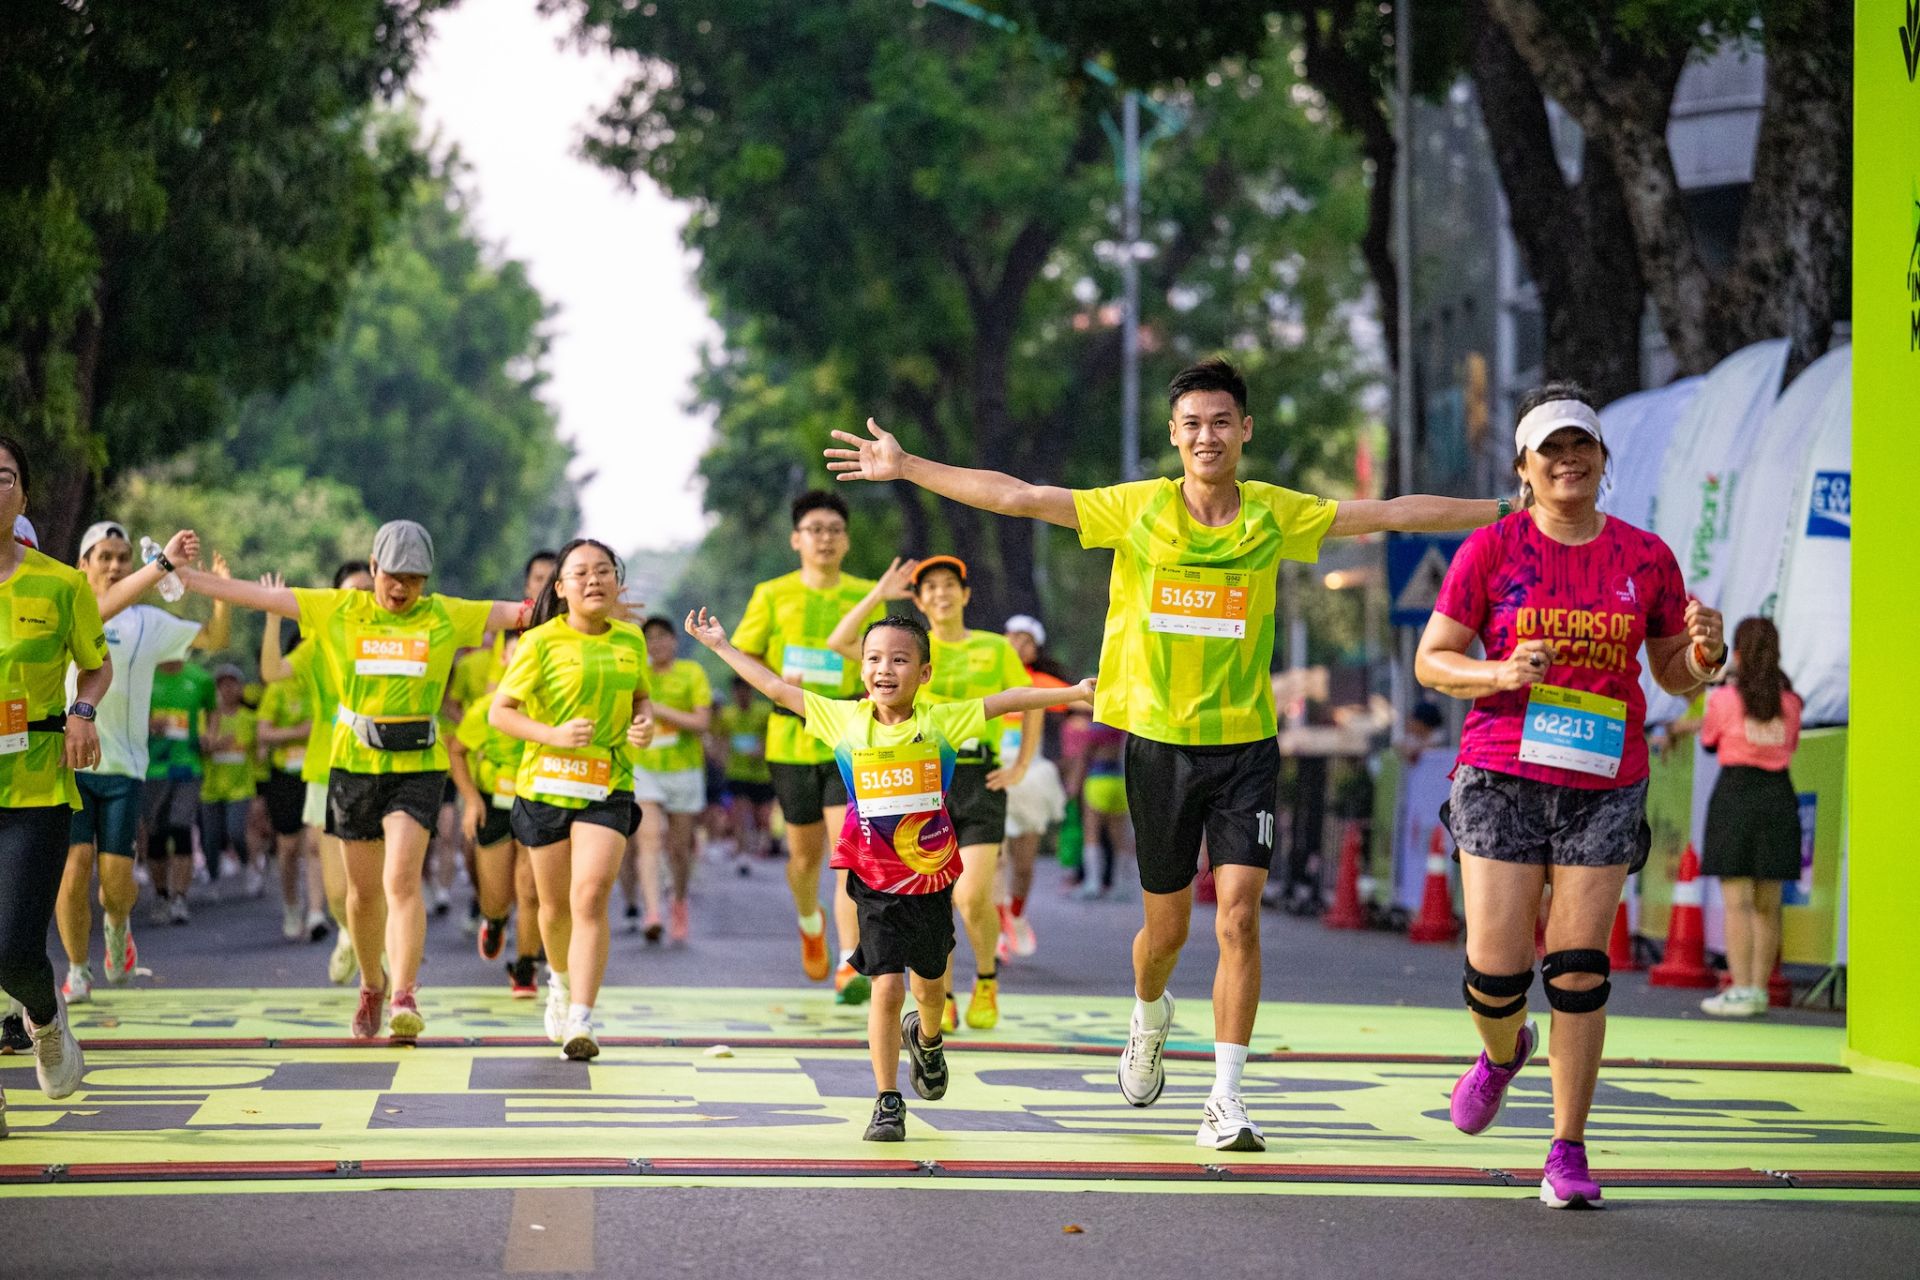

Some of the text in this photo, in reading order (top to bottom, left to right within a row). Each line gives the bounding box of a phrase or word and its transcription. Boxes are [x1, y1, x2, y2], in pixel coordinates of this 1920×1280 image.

[1162, 586, 1215, 608] 51637
[1516, 607, 1636, 641] 10 YEARS OF
[361, 639, 404, 657] 52621
[1534, 712, 1595, 740] 62213
[861, 768, 913, 790] 51638
[1256, 810, 1274, 849] 10
